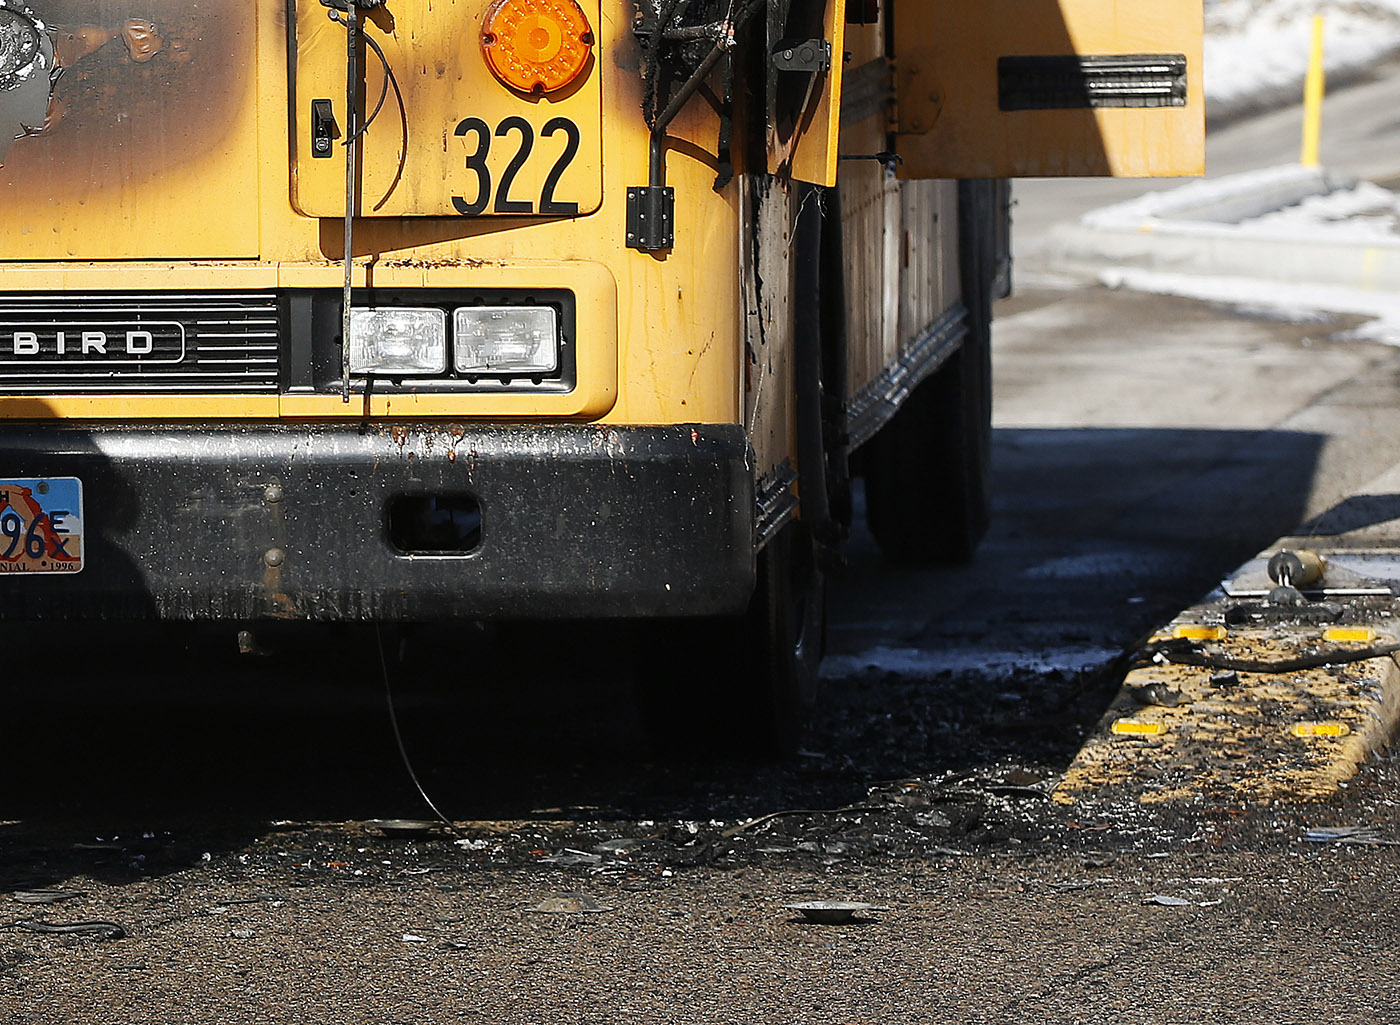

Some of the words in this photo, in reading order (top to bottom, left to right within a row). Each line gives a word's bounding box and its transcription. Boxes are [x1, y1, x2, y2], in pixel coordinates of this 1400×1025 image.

[451, 116, 581, 216] 322
[12, 330, 153, 356] BIRD
[49, 562, 75, 571] 1996
